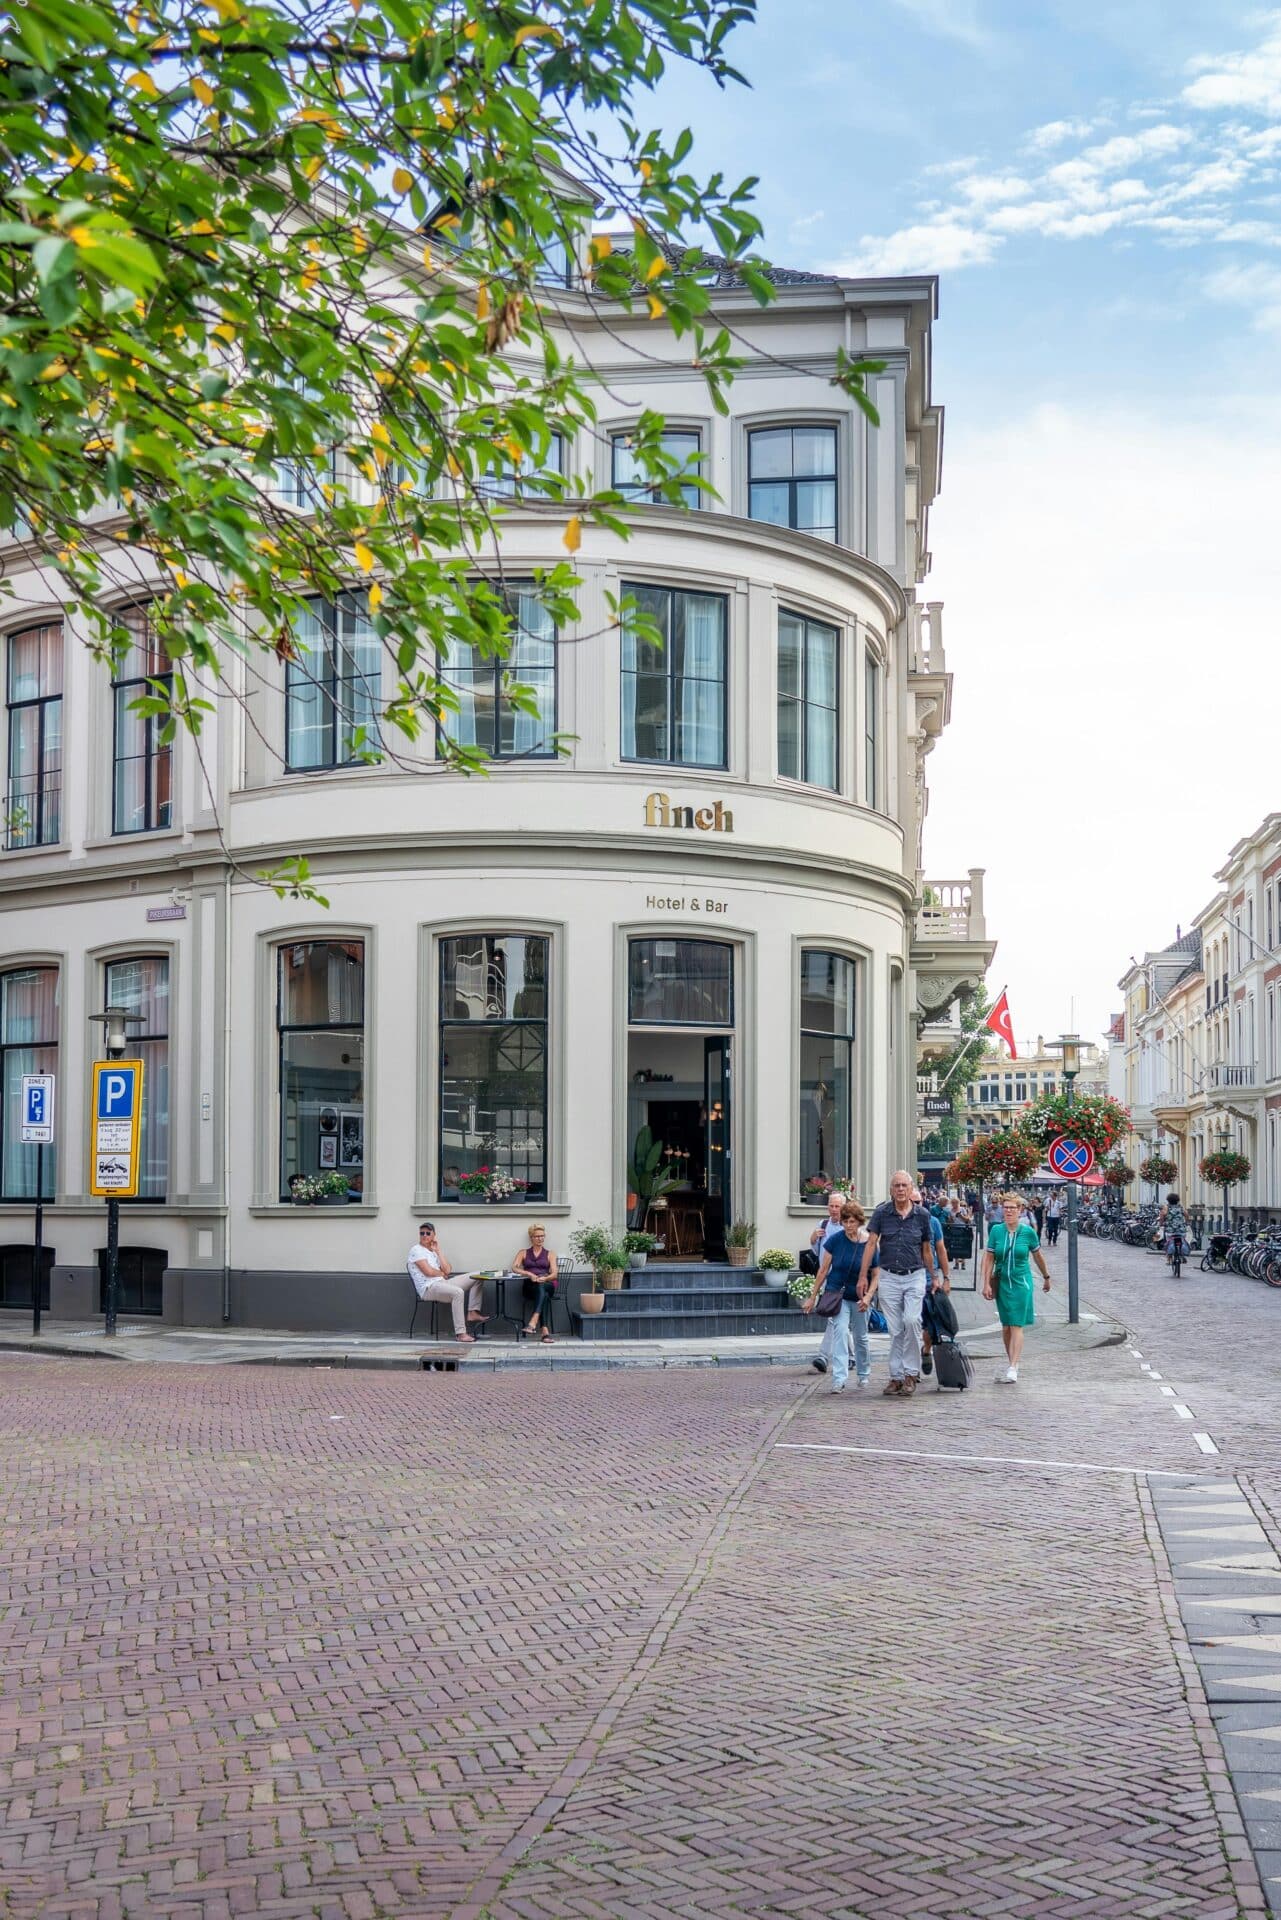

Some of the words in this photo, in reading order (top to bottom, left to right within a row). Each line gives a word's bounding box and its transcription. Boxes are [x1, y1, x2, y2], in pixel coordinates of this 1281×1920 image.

[643, 792, 734, 832] finch
[646, 895, 685, 910] Hotel
[690, 899, 700, 911] &
[705, 899, 729, 913] Bar
[31, 1090, 41, 1108] P
[106, 1076, 126, 1113] P
[927, 1100, 951, 1110] finch
